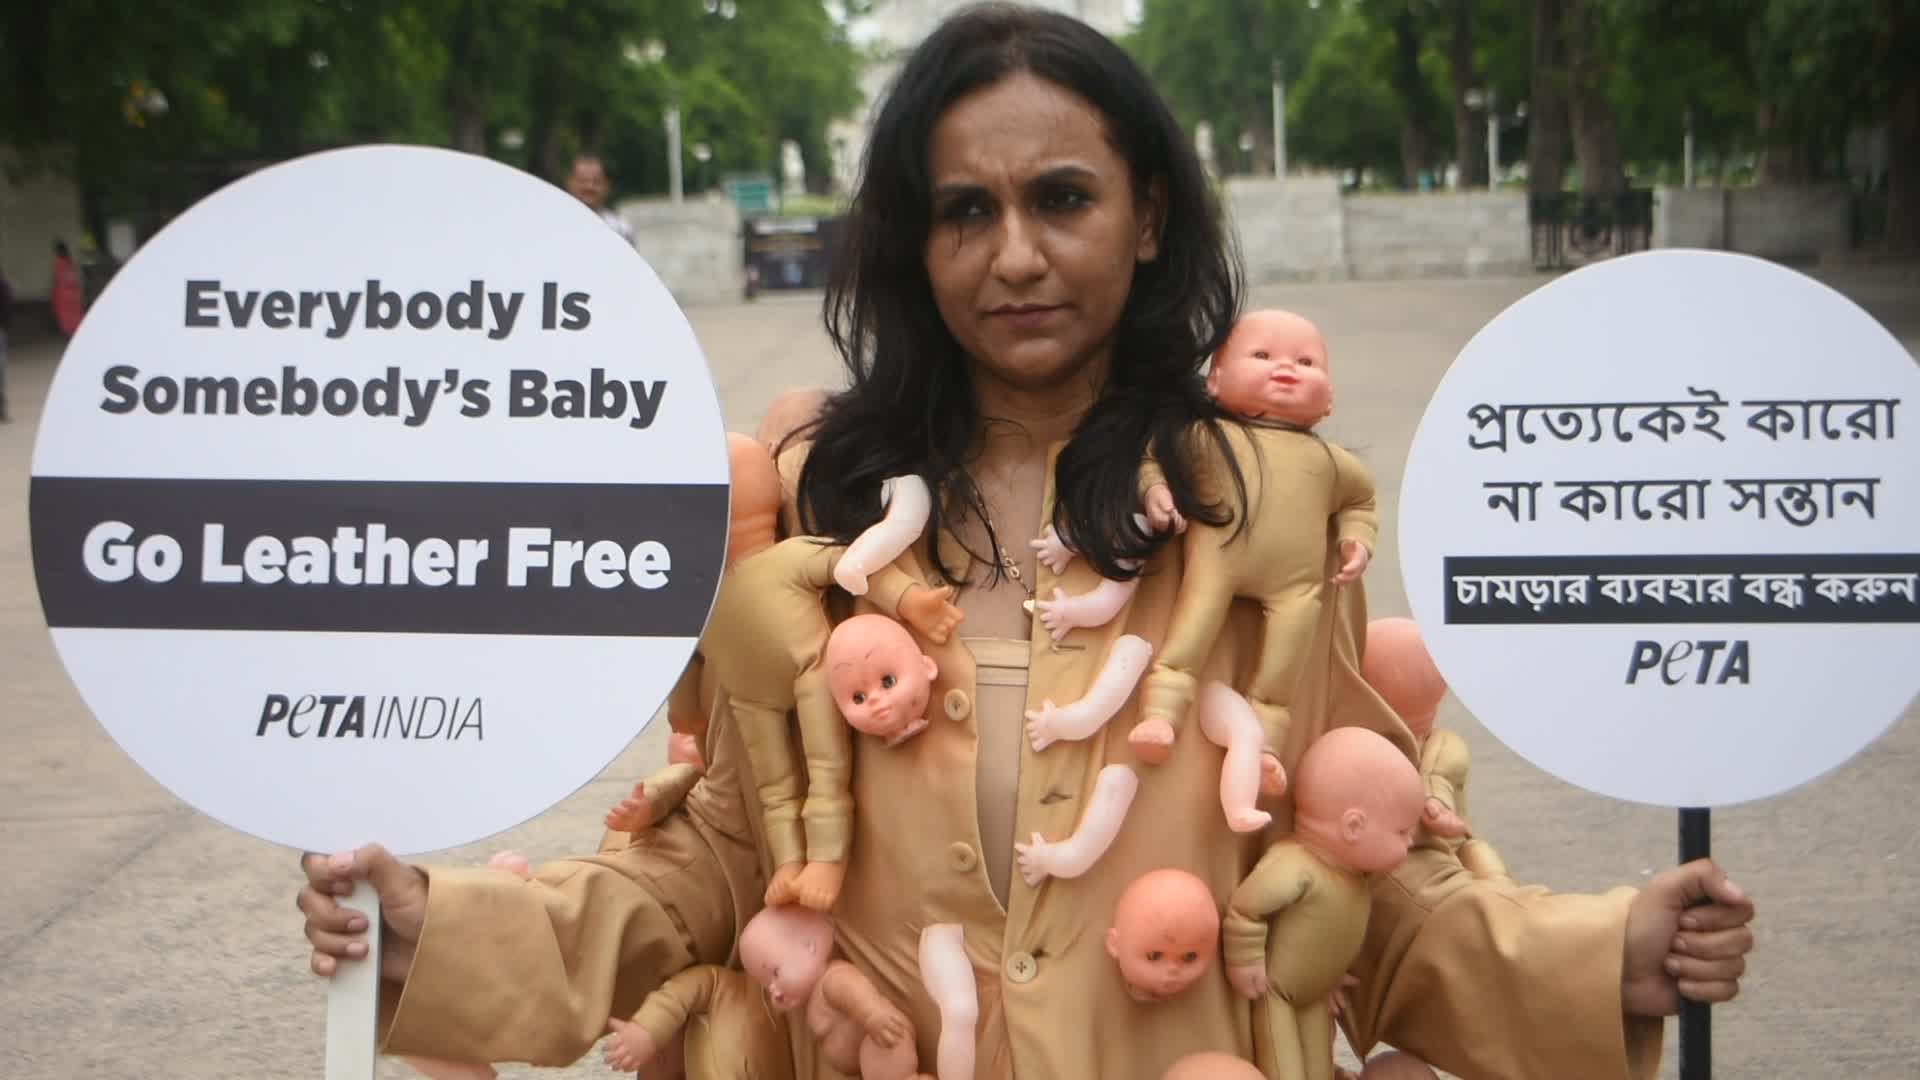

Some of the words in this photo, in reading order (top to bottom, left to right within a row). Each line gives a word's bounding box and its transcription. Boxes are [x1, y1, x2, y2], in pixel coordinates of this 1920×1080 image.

[184, 279, 525, 341] Everybody
[541, 281, 591, 331] Is
[100, 364, 491, 427] Somebody’s
[508, 367, 668, 430] Baby
[1467, 386, 1729, 453] প্রত্যেকেই
[1741, 398, 1901, 441] কারো
[1483, 481, 1543, 523] না
[1554, 479, 1712, 522] কারো
[1723, 477, 1881, 527] সন্তান
[82, 520, 183, 583] Go
[201, 523, 489, 587] Leather
[506, 527, 671, 590] Free
[1452, 574, 1591, 612] চামড়ার
[1596, 573, 1734, 604] ব্যবহার
[1740, 573, 1805, 609] বন্ধ
[1811, 573, 1918, 604] করুন
[372, 695, 483, 741] INDIA
